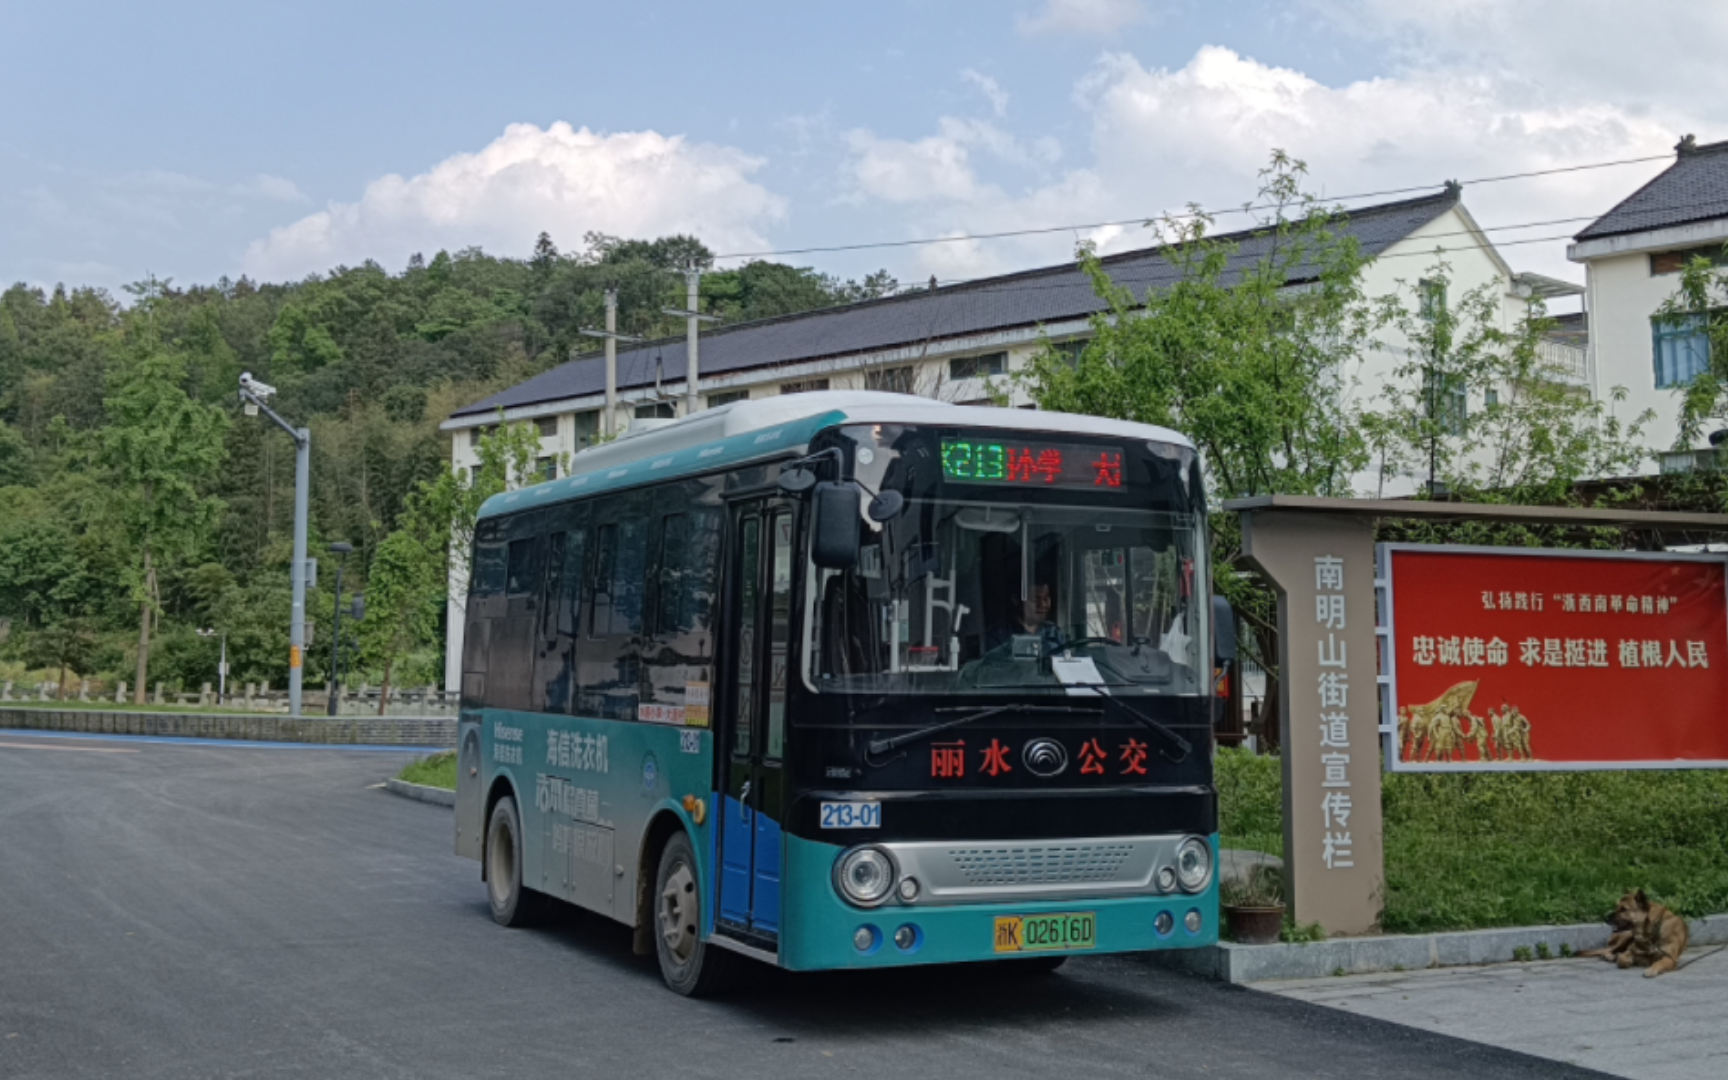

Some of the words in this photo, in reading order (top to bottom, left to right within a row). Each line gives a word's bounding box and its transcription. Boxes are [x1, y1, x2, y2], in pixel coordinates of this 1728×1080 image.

[1481, 591, 1544, 612] 弘扬践行
[1412, 636, 1509, 667] 忠诚使命
[1518, 638, 1609, 668] 求是挺进
[1618, 640, 1709, 669] 植根人民
[1313, 554, 1354, 870] 南明山街道宣传栏
[546, 729, 608, 774] 海信洗衣机
[822, 803, 881, 827] 213-01
